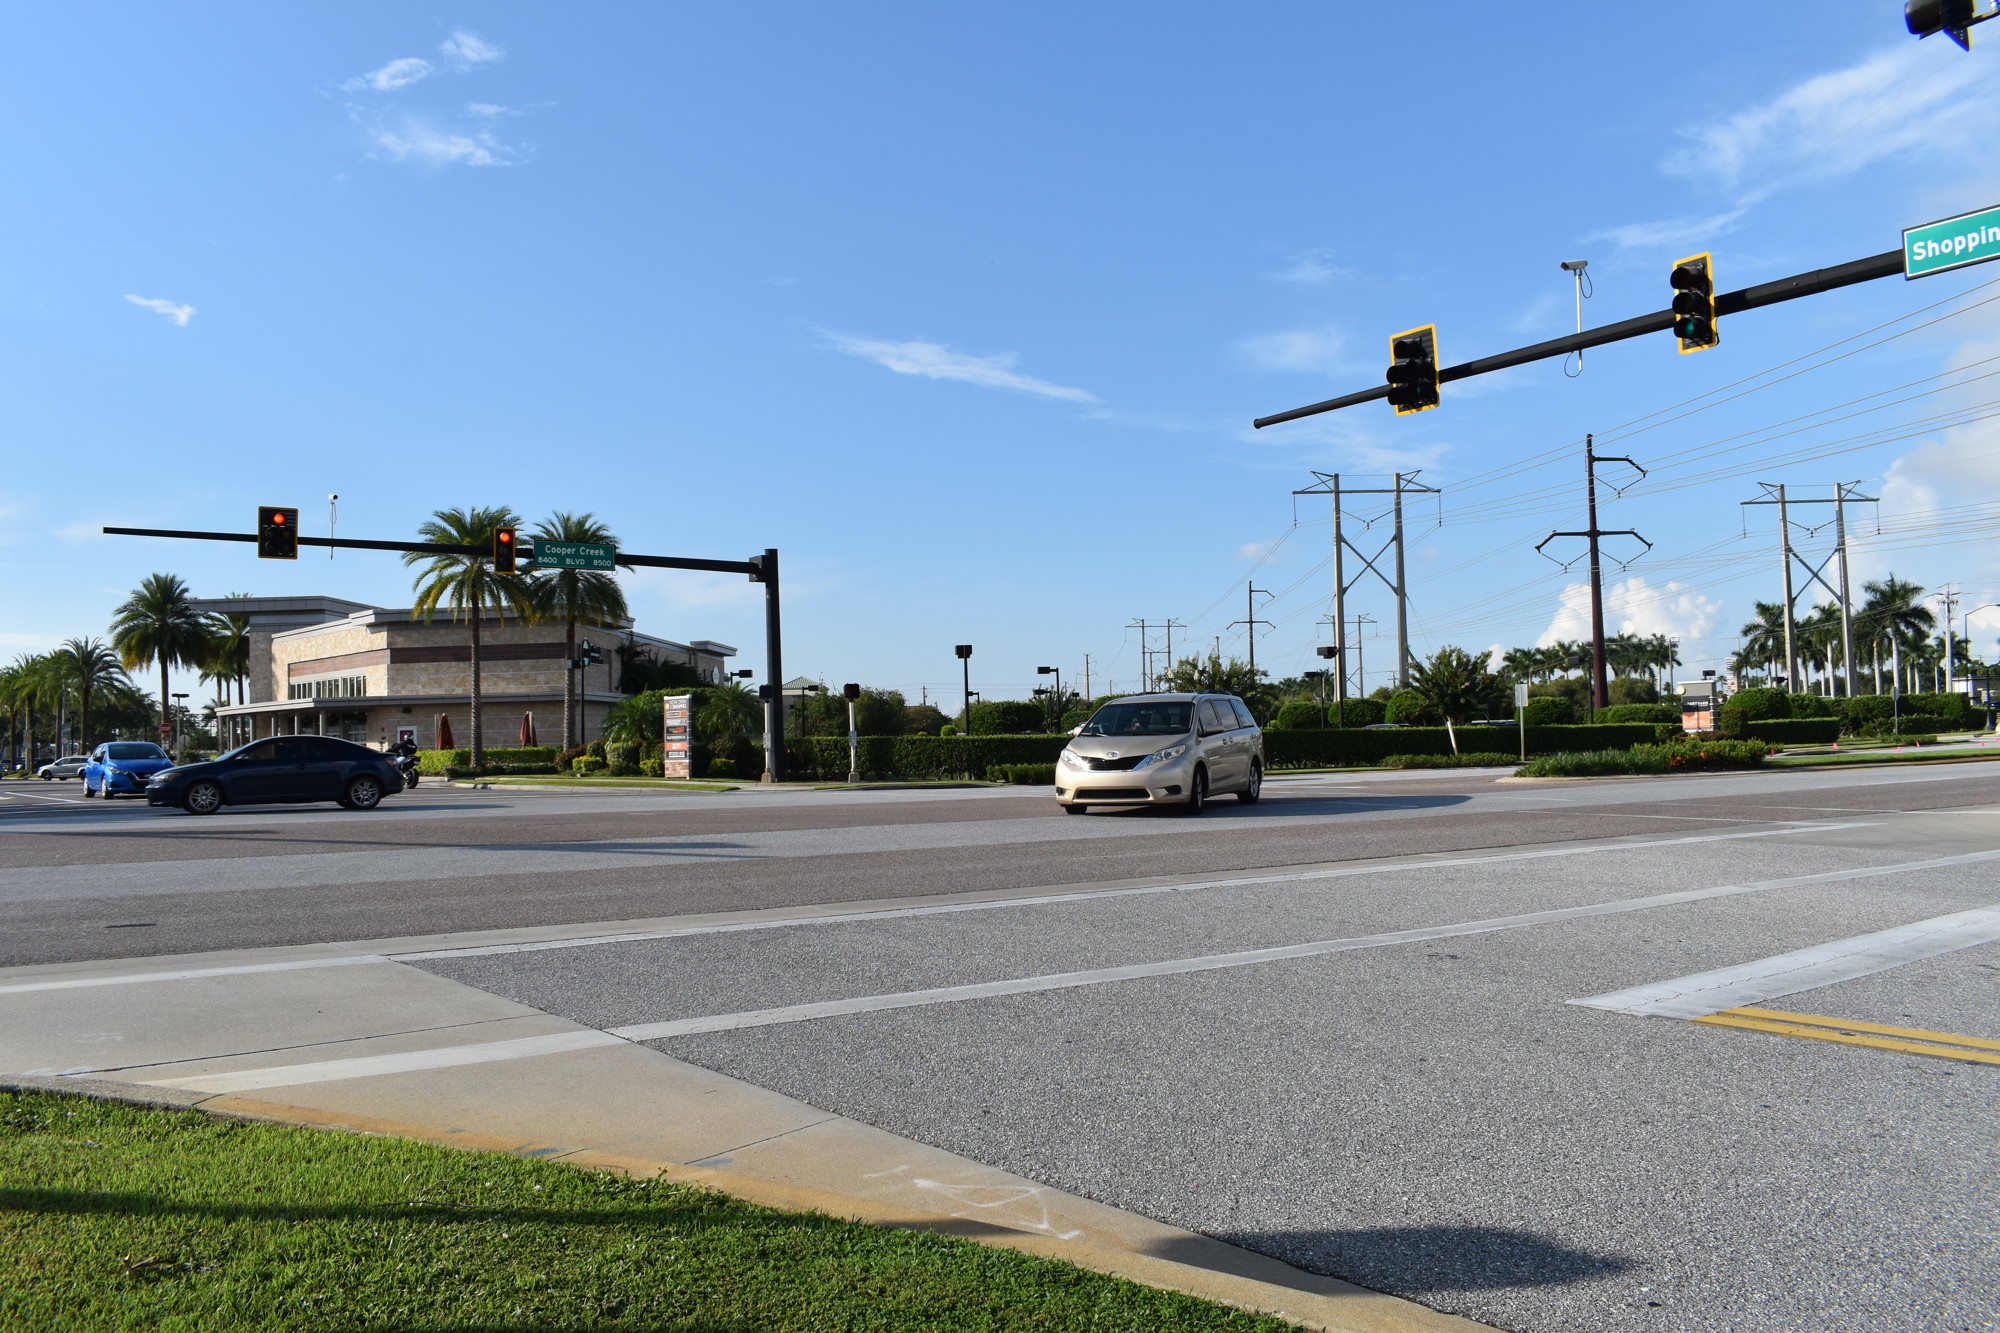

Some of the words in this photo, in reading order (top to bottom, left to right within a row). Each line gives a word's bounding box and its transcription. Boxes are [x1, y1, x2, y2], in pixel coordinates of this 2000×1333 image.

[1912, 226, 2000, 261] Shoppin
[545, 545, 576, 556] Cooper
[580, 547, 605, 556] Creek
[538, 556, 558, 564] 8400
